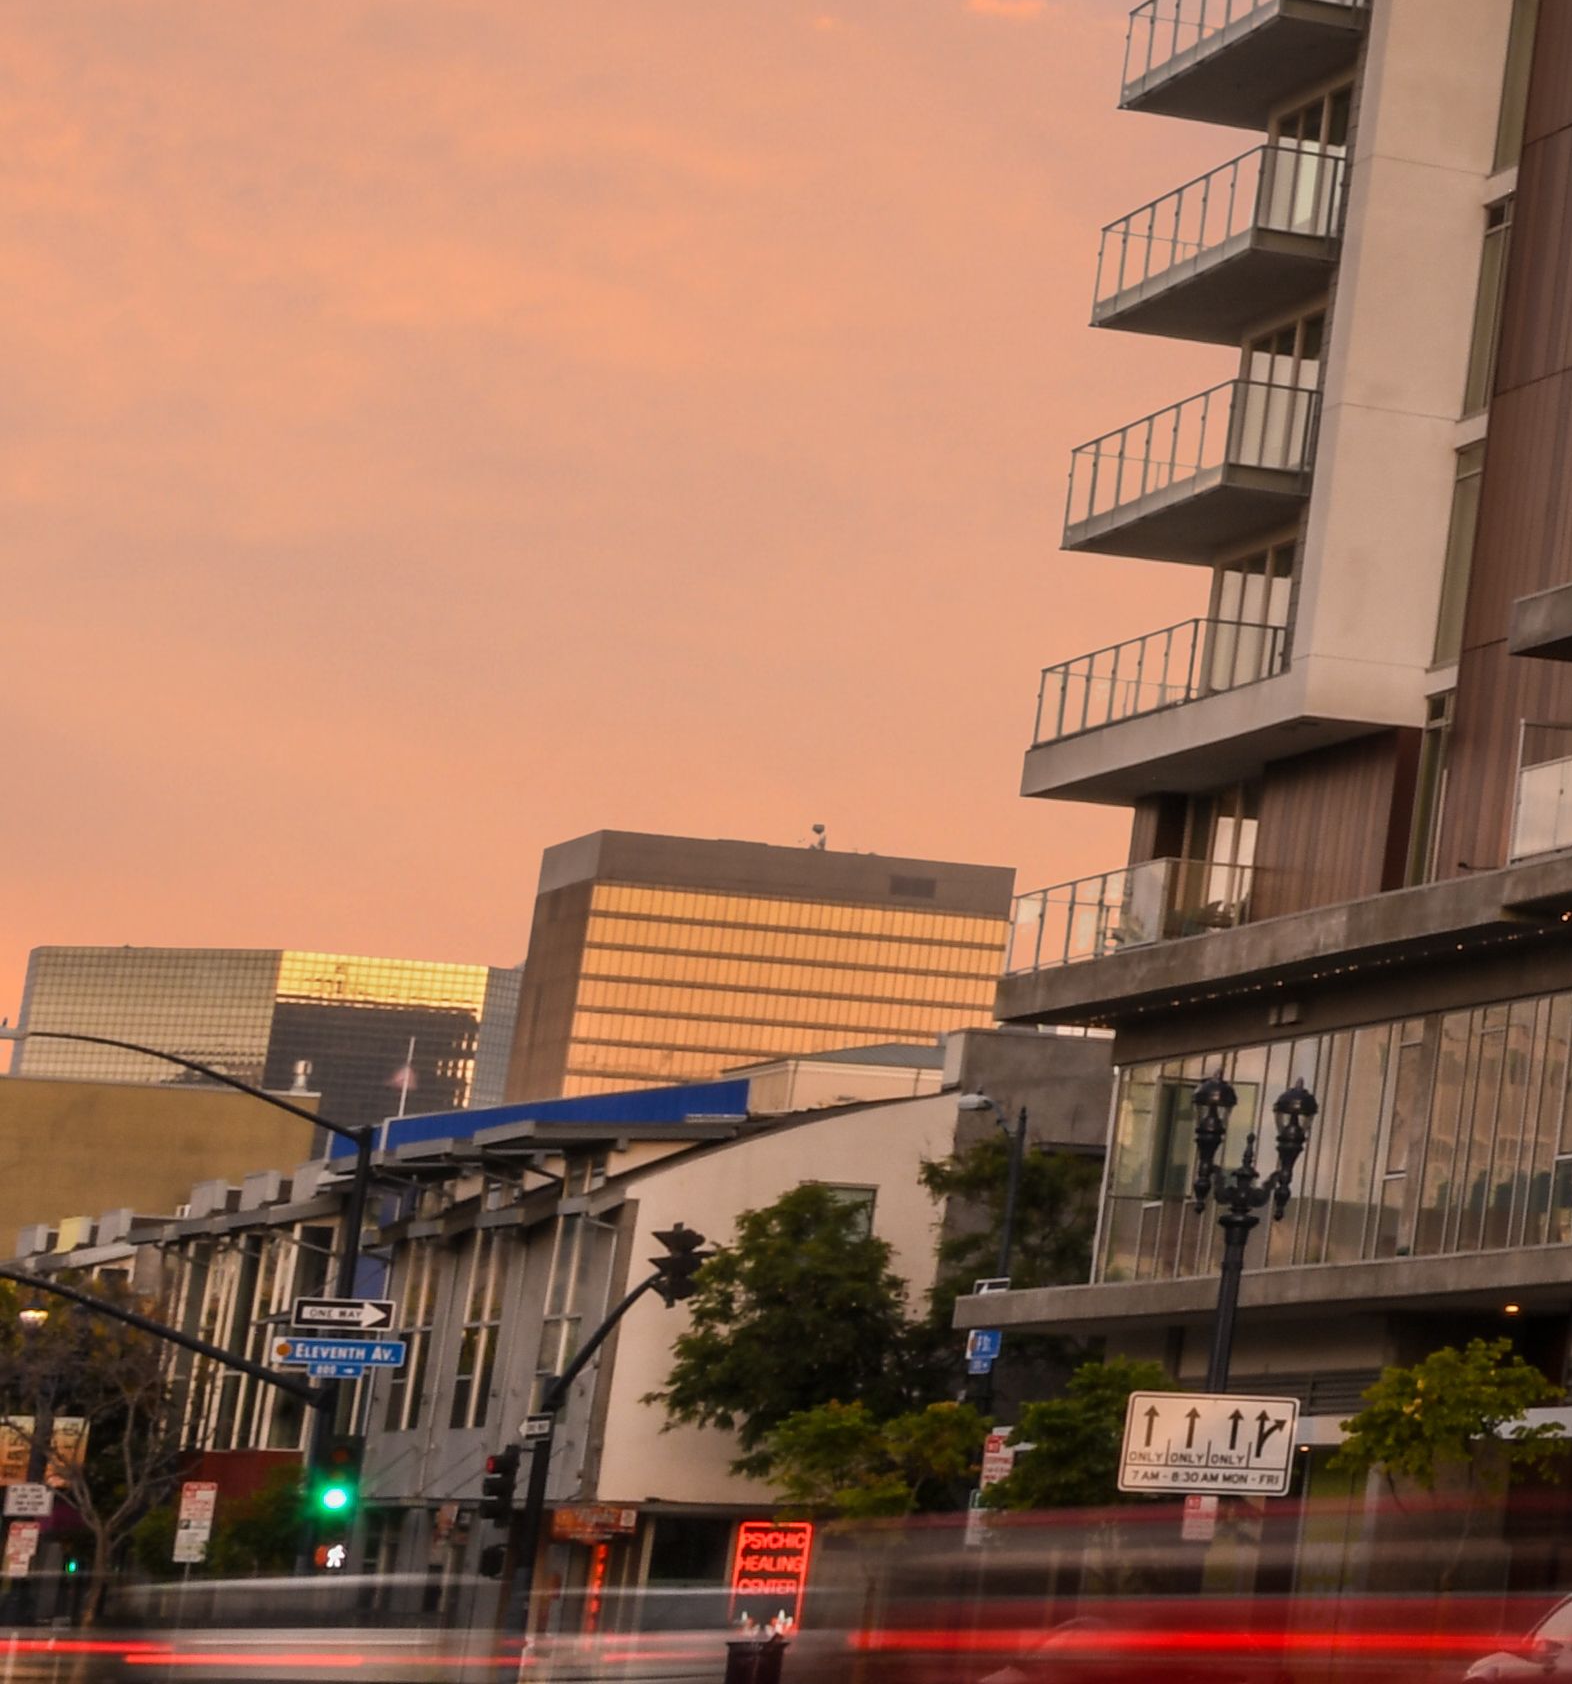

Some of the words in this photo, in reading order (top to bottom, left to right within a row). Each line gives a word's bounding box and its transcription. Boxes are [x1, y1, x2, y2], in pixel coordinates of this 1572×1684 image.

[309, 1308, 332, 1318] ONE
[338, 1309, 361, 1319] WAY
[1128, 1451, 1163, 1462] ONLY
[1170, 1452, 1205, 1464] ONLY
[1211, 1454, 1245, 1465] ONLY
[1142, 1471, 1160, 1481] AM
[1201, 1472, 1219, 1483] AM
[1222, 1473, 1248, 1484] MON
[1258, 1473, 1280, 1485] FRI
[744, 1532, 806, 1550] PSYCHIC
[742, 1555, 804, 1573] HEALING
[739, 1578, 798, 1594] CENTER
